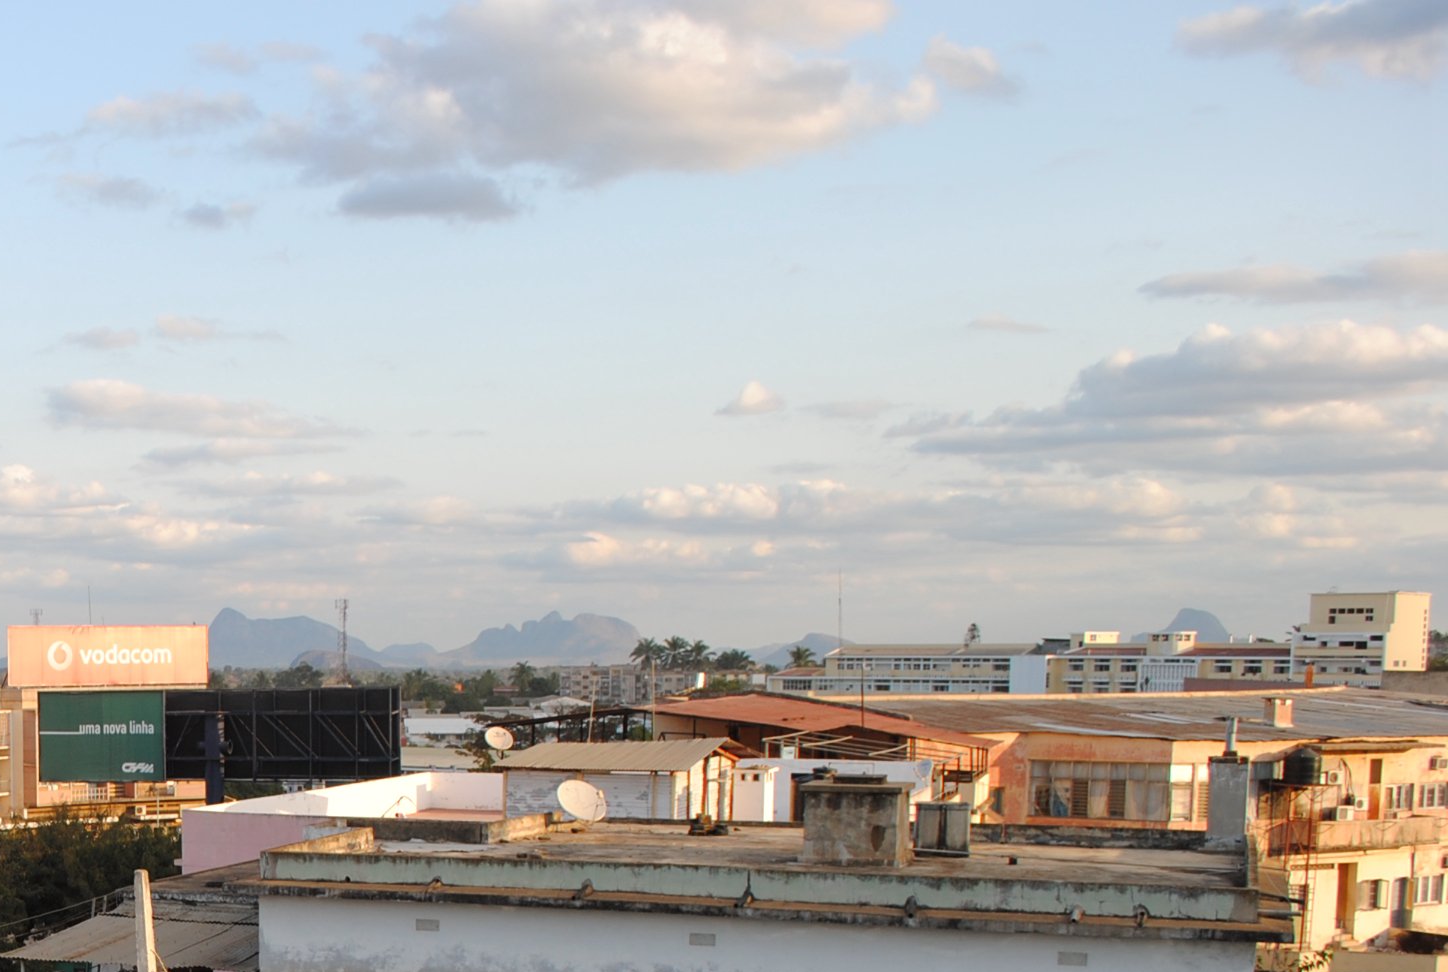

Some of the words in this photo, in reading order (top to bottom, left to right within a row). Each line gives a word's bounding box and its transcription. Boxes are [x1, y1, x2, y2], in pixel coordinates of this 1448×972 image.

[79, 643, 172, 664] vodacom
[79, 724, 101, 735] uma
[103, 724, 127, 735] nova
[129, 720, 155, 735] linha
